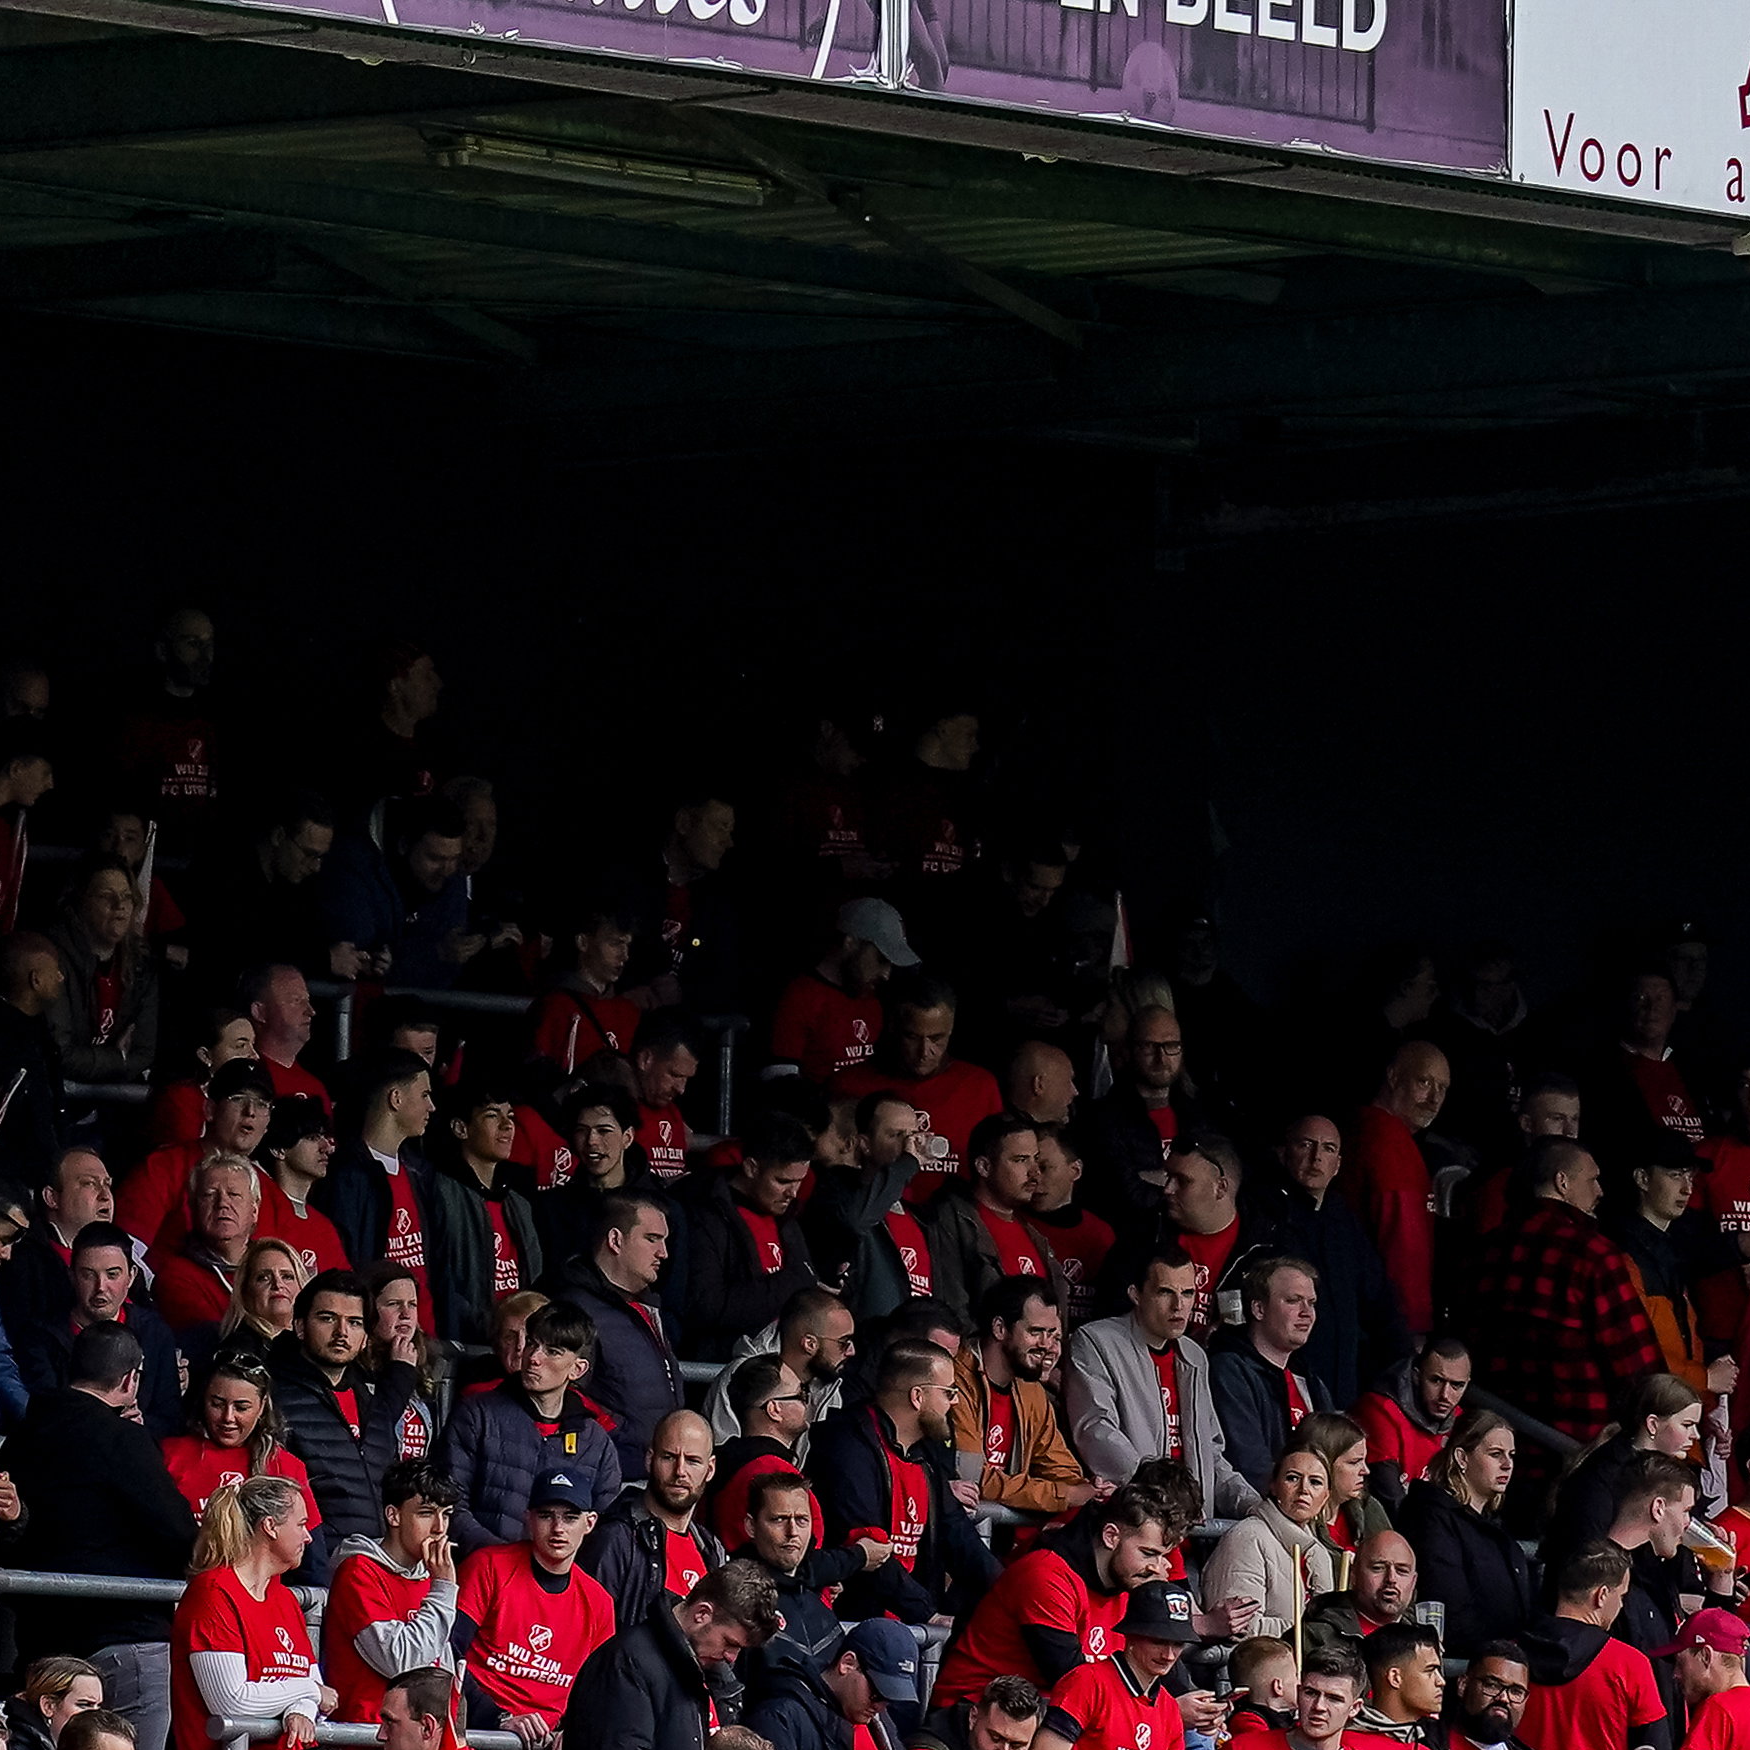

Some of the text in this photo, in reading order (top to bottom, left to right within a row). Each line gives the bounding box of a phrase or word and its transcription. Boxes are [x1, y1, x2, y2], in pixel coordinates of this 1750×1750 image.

[1543, 109, 1674, 192] Voor
[1721, 1222, 1737, 1232] FC
[273, 1652, 290, 1665] WIJ
[487, 1657, 573, 1687] FC UTRECHT
[504, 1643, 561, 1672] WIJ ZIJN
